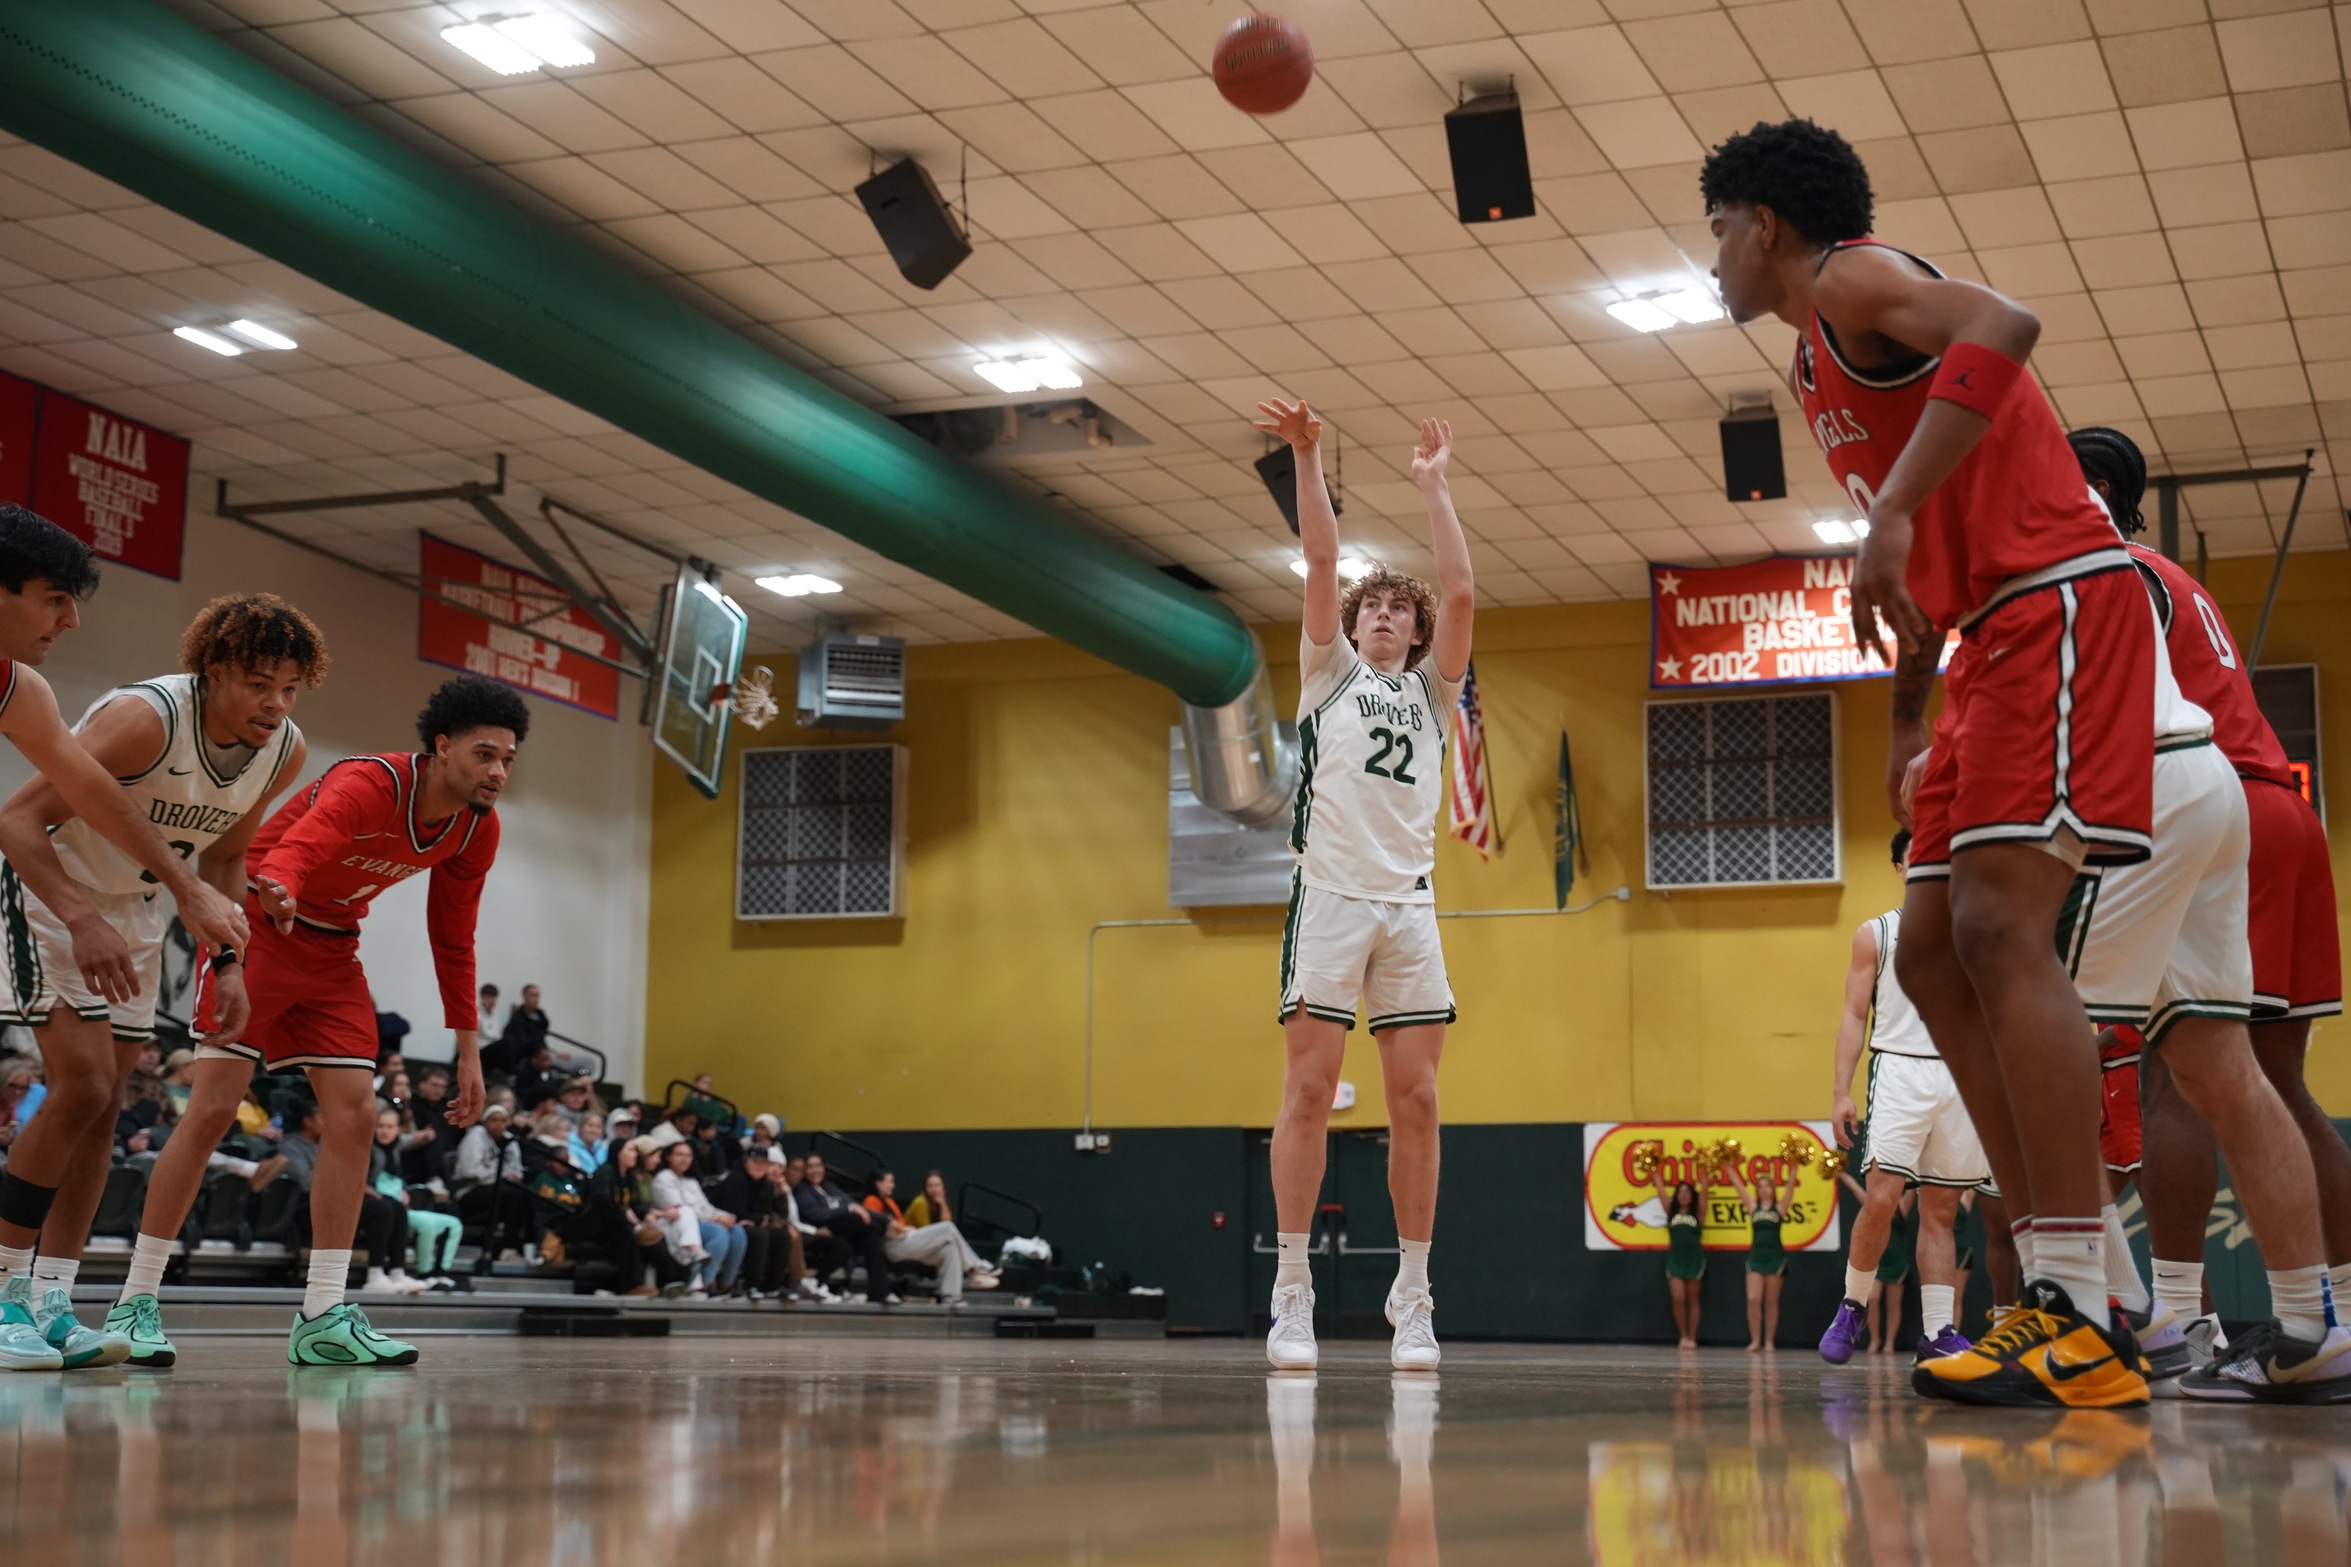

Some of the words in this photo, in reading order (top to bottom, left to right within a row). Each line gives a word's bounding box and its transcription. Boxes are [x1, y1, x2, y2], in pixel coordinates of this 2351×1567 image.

[86, 411, 148, 472] NAIA
[1803, 557, 1855, 589] NAI
[1676, 590, 1817, 627] NATIONAL
[1690, 650, 1761, 684] 2002
[1356, 693, 1423, 731] DRVERS
[1364, 727, 1416, 786] 22
[149, 798, 246, 835] DROVER
